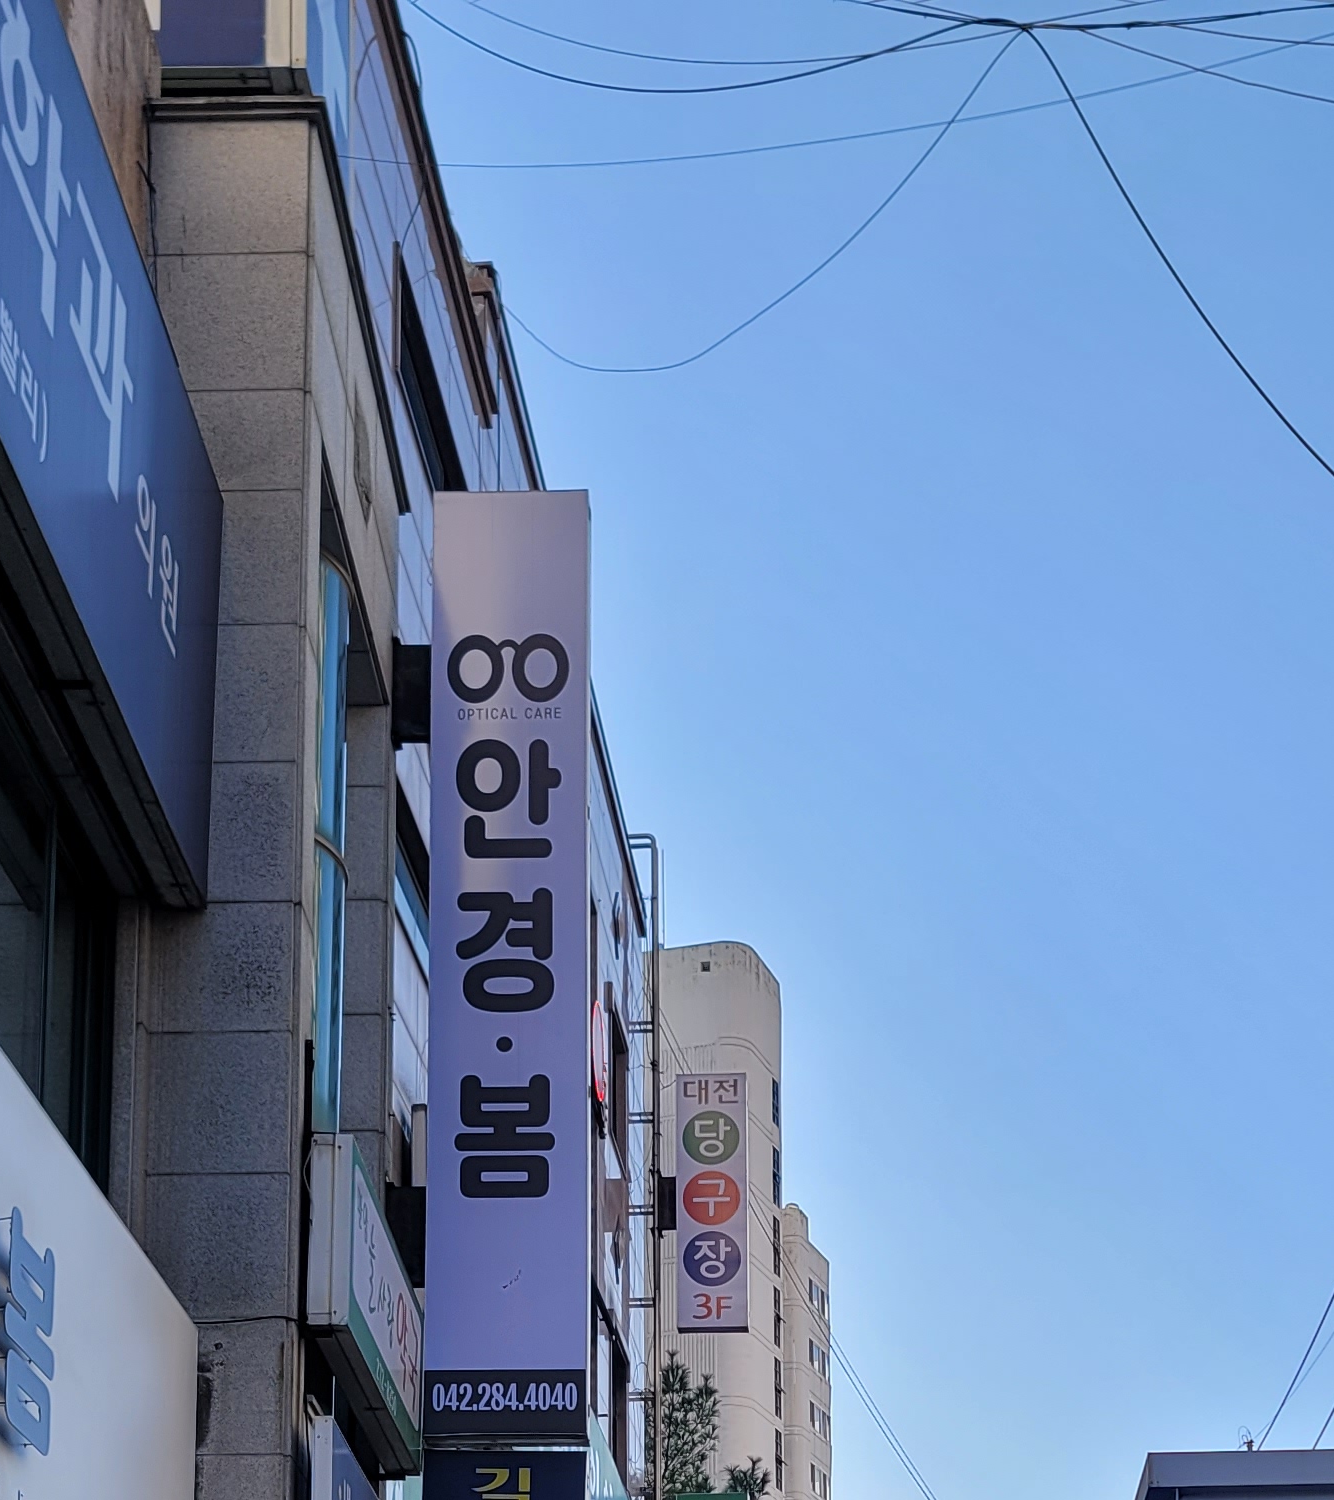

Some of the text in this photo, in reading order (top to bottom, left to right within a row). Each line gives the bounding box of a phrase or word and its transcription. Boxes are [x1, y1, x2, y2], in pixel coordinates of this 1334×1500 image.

[136, 474, 180, 659] 의원
[457, 706, 563, 721] OPTICAL CARE
[682, 1078, 739, 1105] 대전
[692, 1117, 732, 1280] 당구장
[692, 1292, 734, 1321] 3F
[432, 1382, 578, 1412] 042.284.4040
